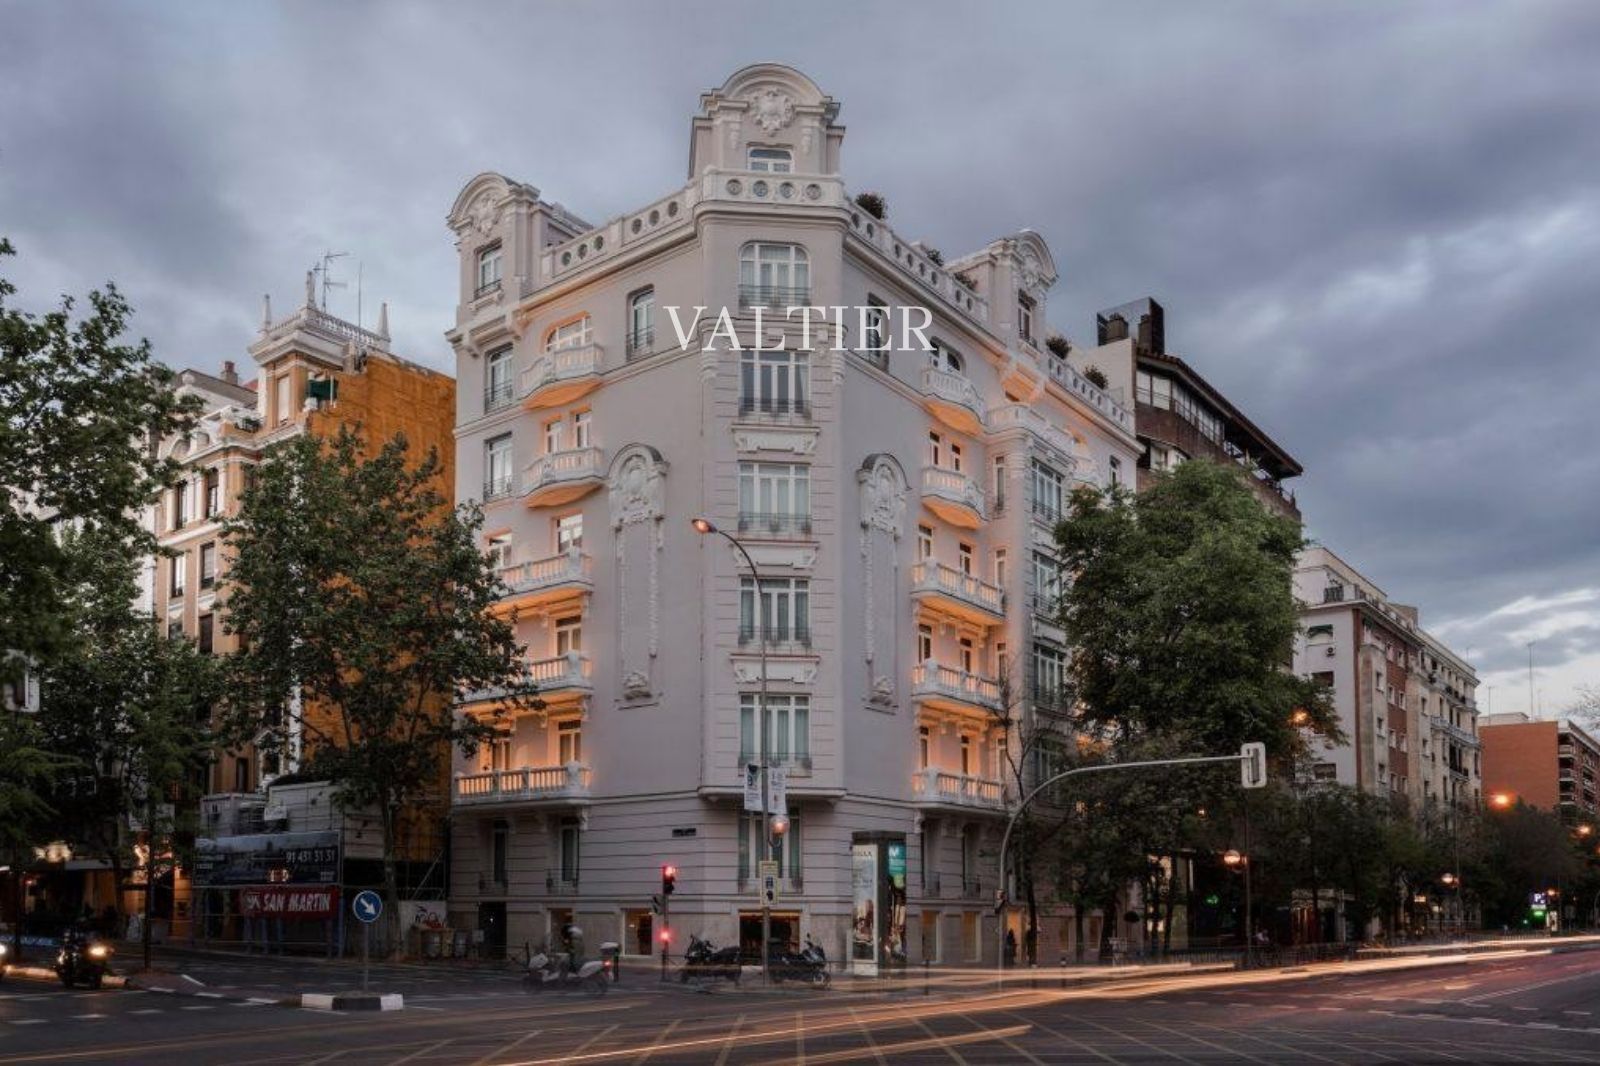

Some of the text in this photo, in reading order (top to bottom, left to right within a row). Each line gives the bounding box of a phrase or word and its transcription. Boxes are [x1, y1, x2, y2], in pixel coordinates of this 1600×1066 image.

[286, 851, 296, 863] 91
[263, 893, 285, 912] SAN
[287, 893, 332, 912] MARTIN
